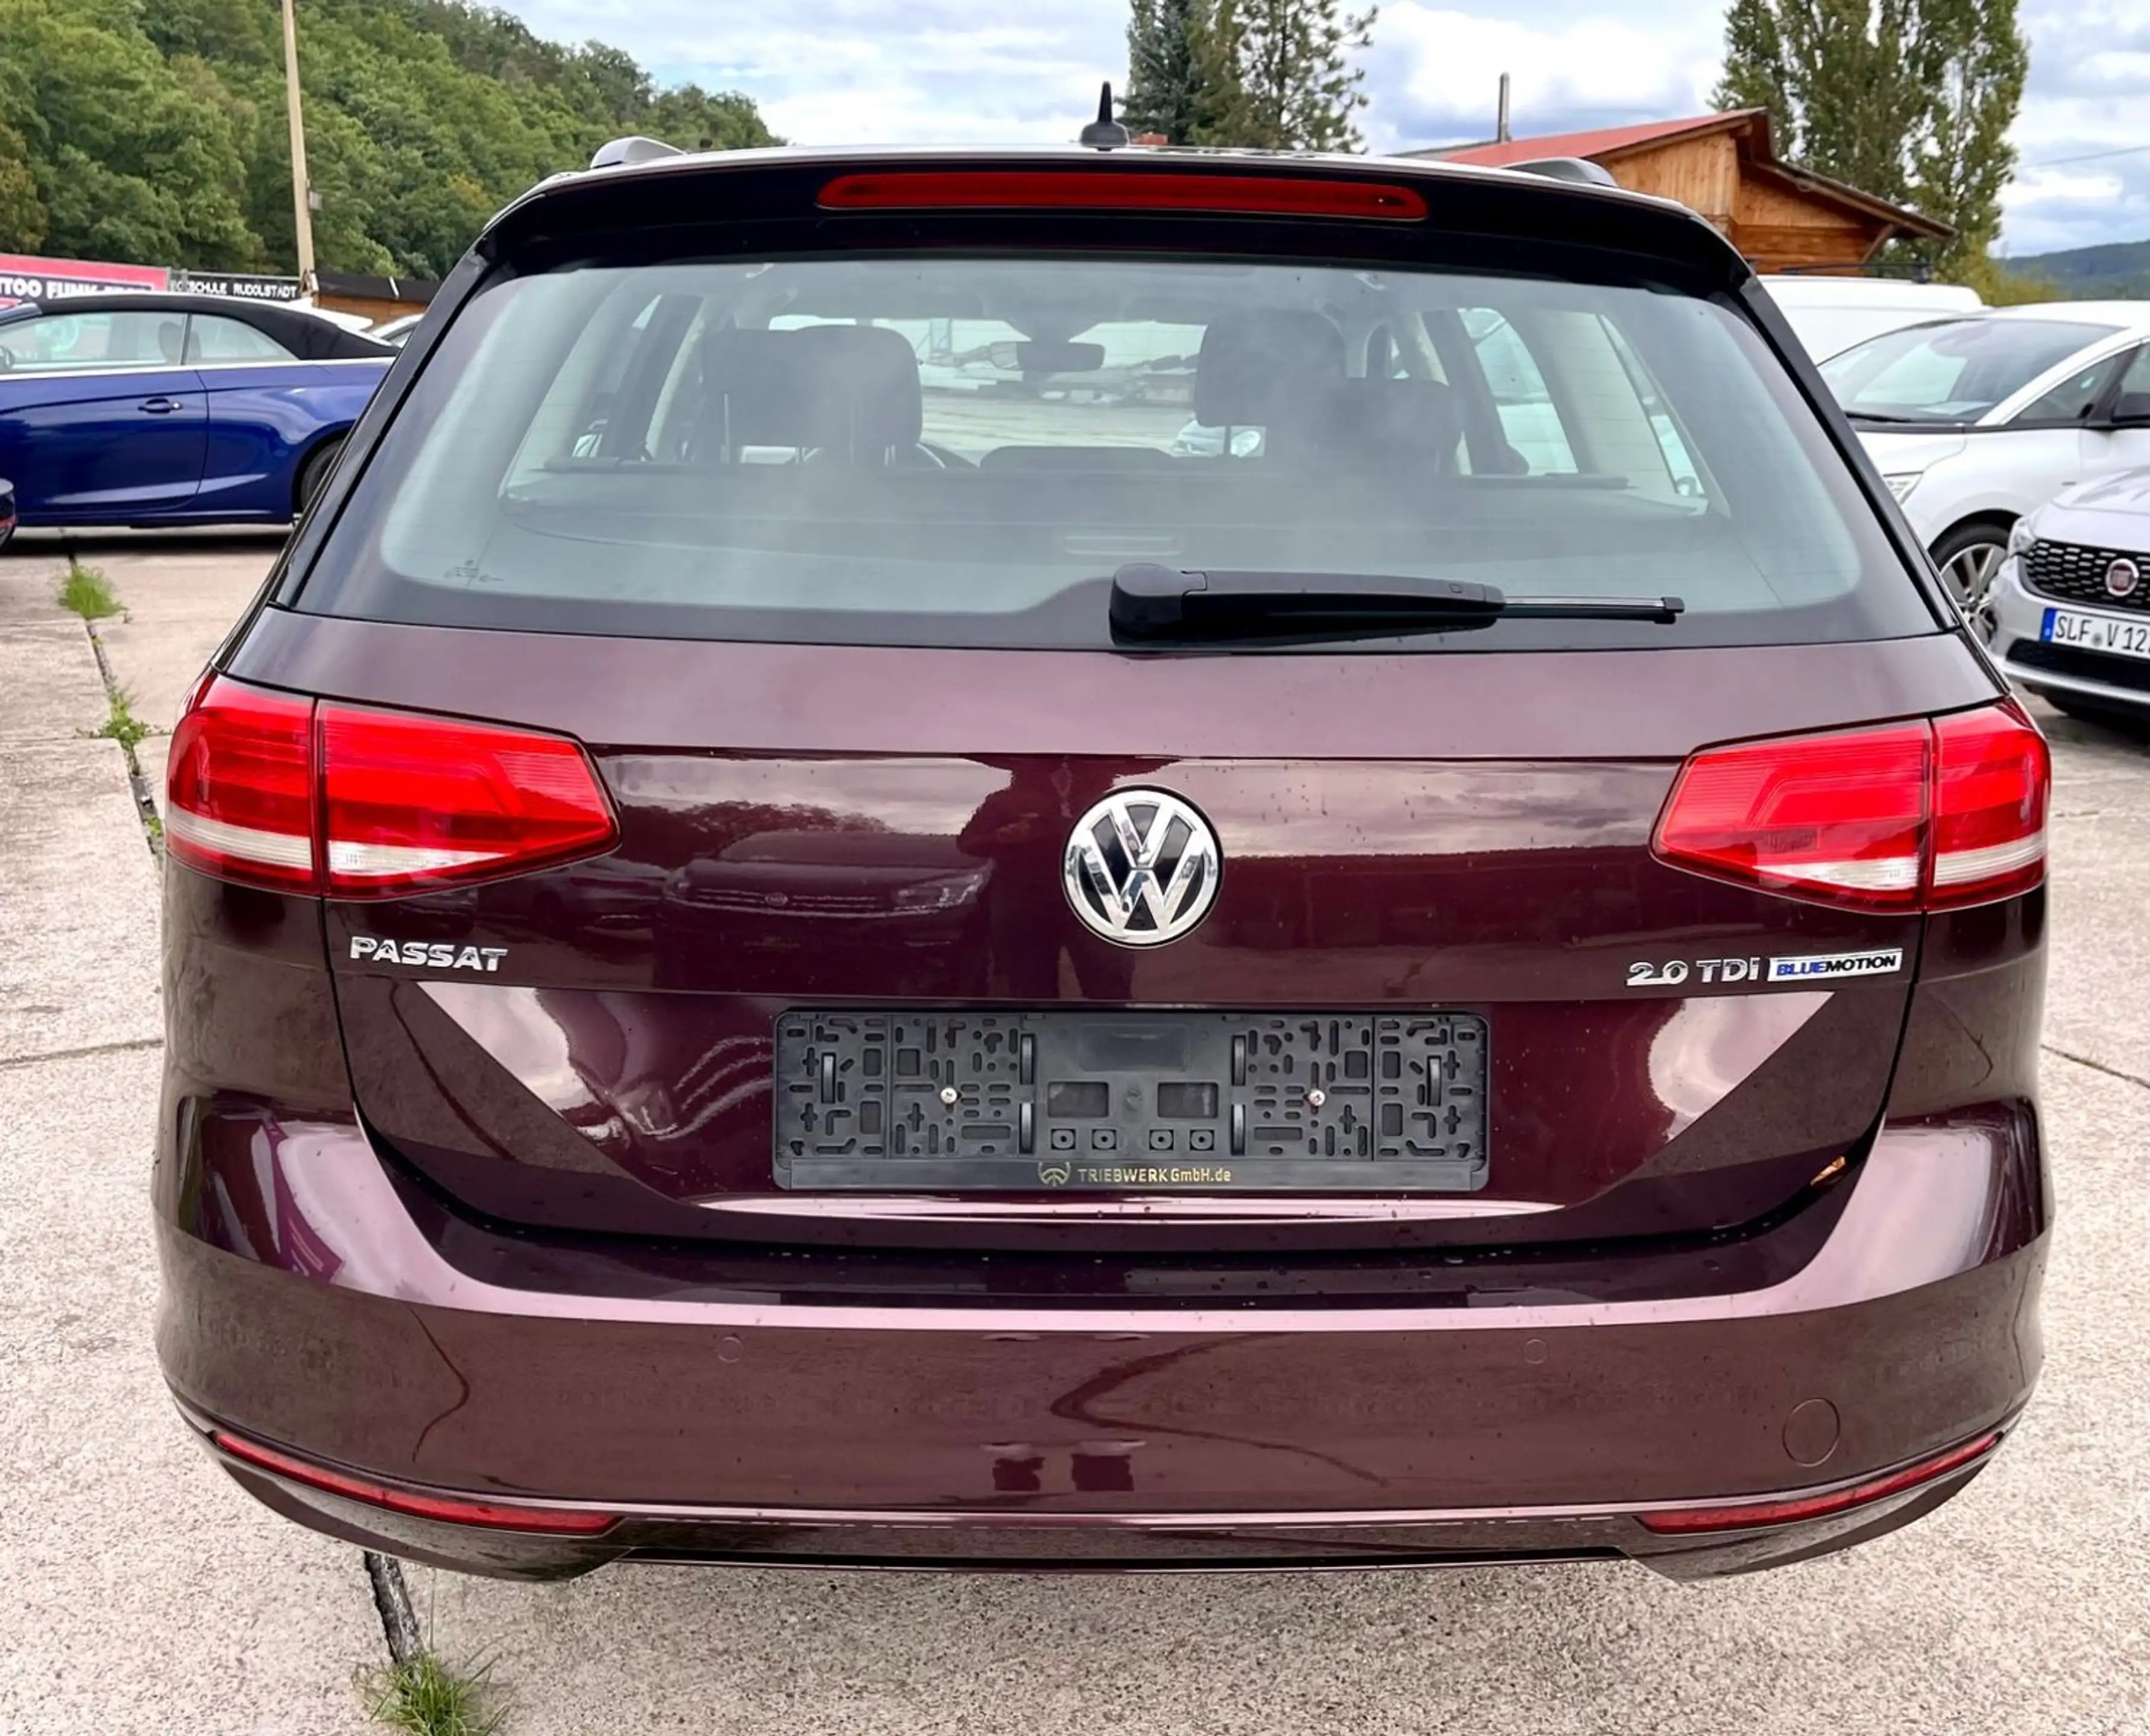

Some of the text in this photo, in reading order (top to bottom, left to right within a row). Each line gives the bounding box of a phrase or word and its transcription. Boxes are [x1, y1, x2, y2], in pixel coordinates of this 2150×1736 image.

[2055, 615, 2150, 655] SLF V 12
[350, 936, 509, 972] PASSAT
[1776, 955, 1897, 976] BLUEMOTION
[1077, 1168, 1231, 1183] TRIEBWERK GmbH.de
